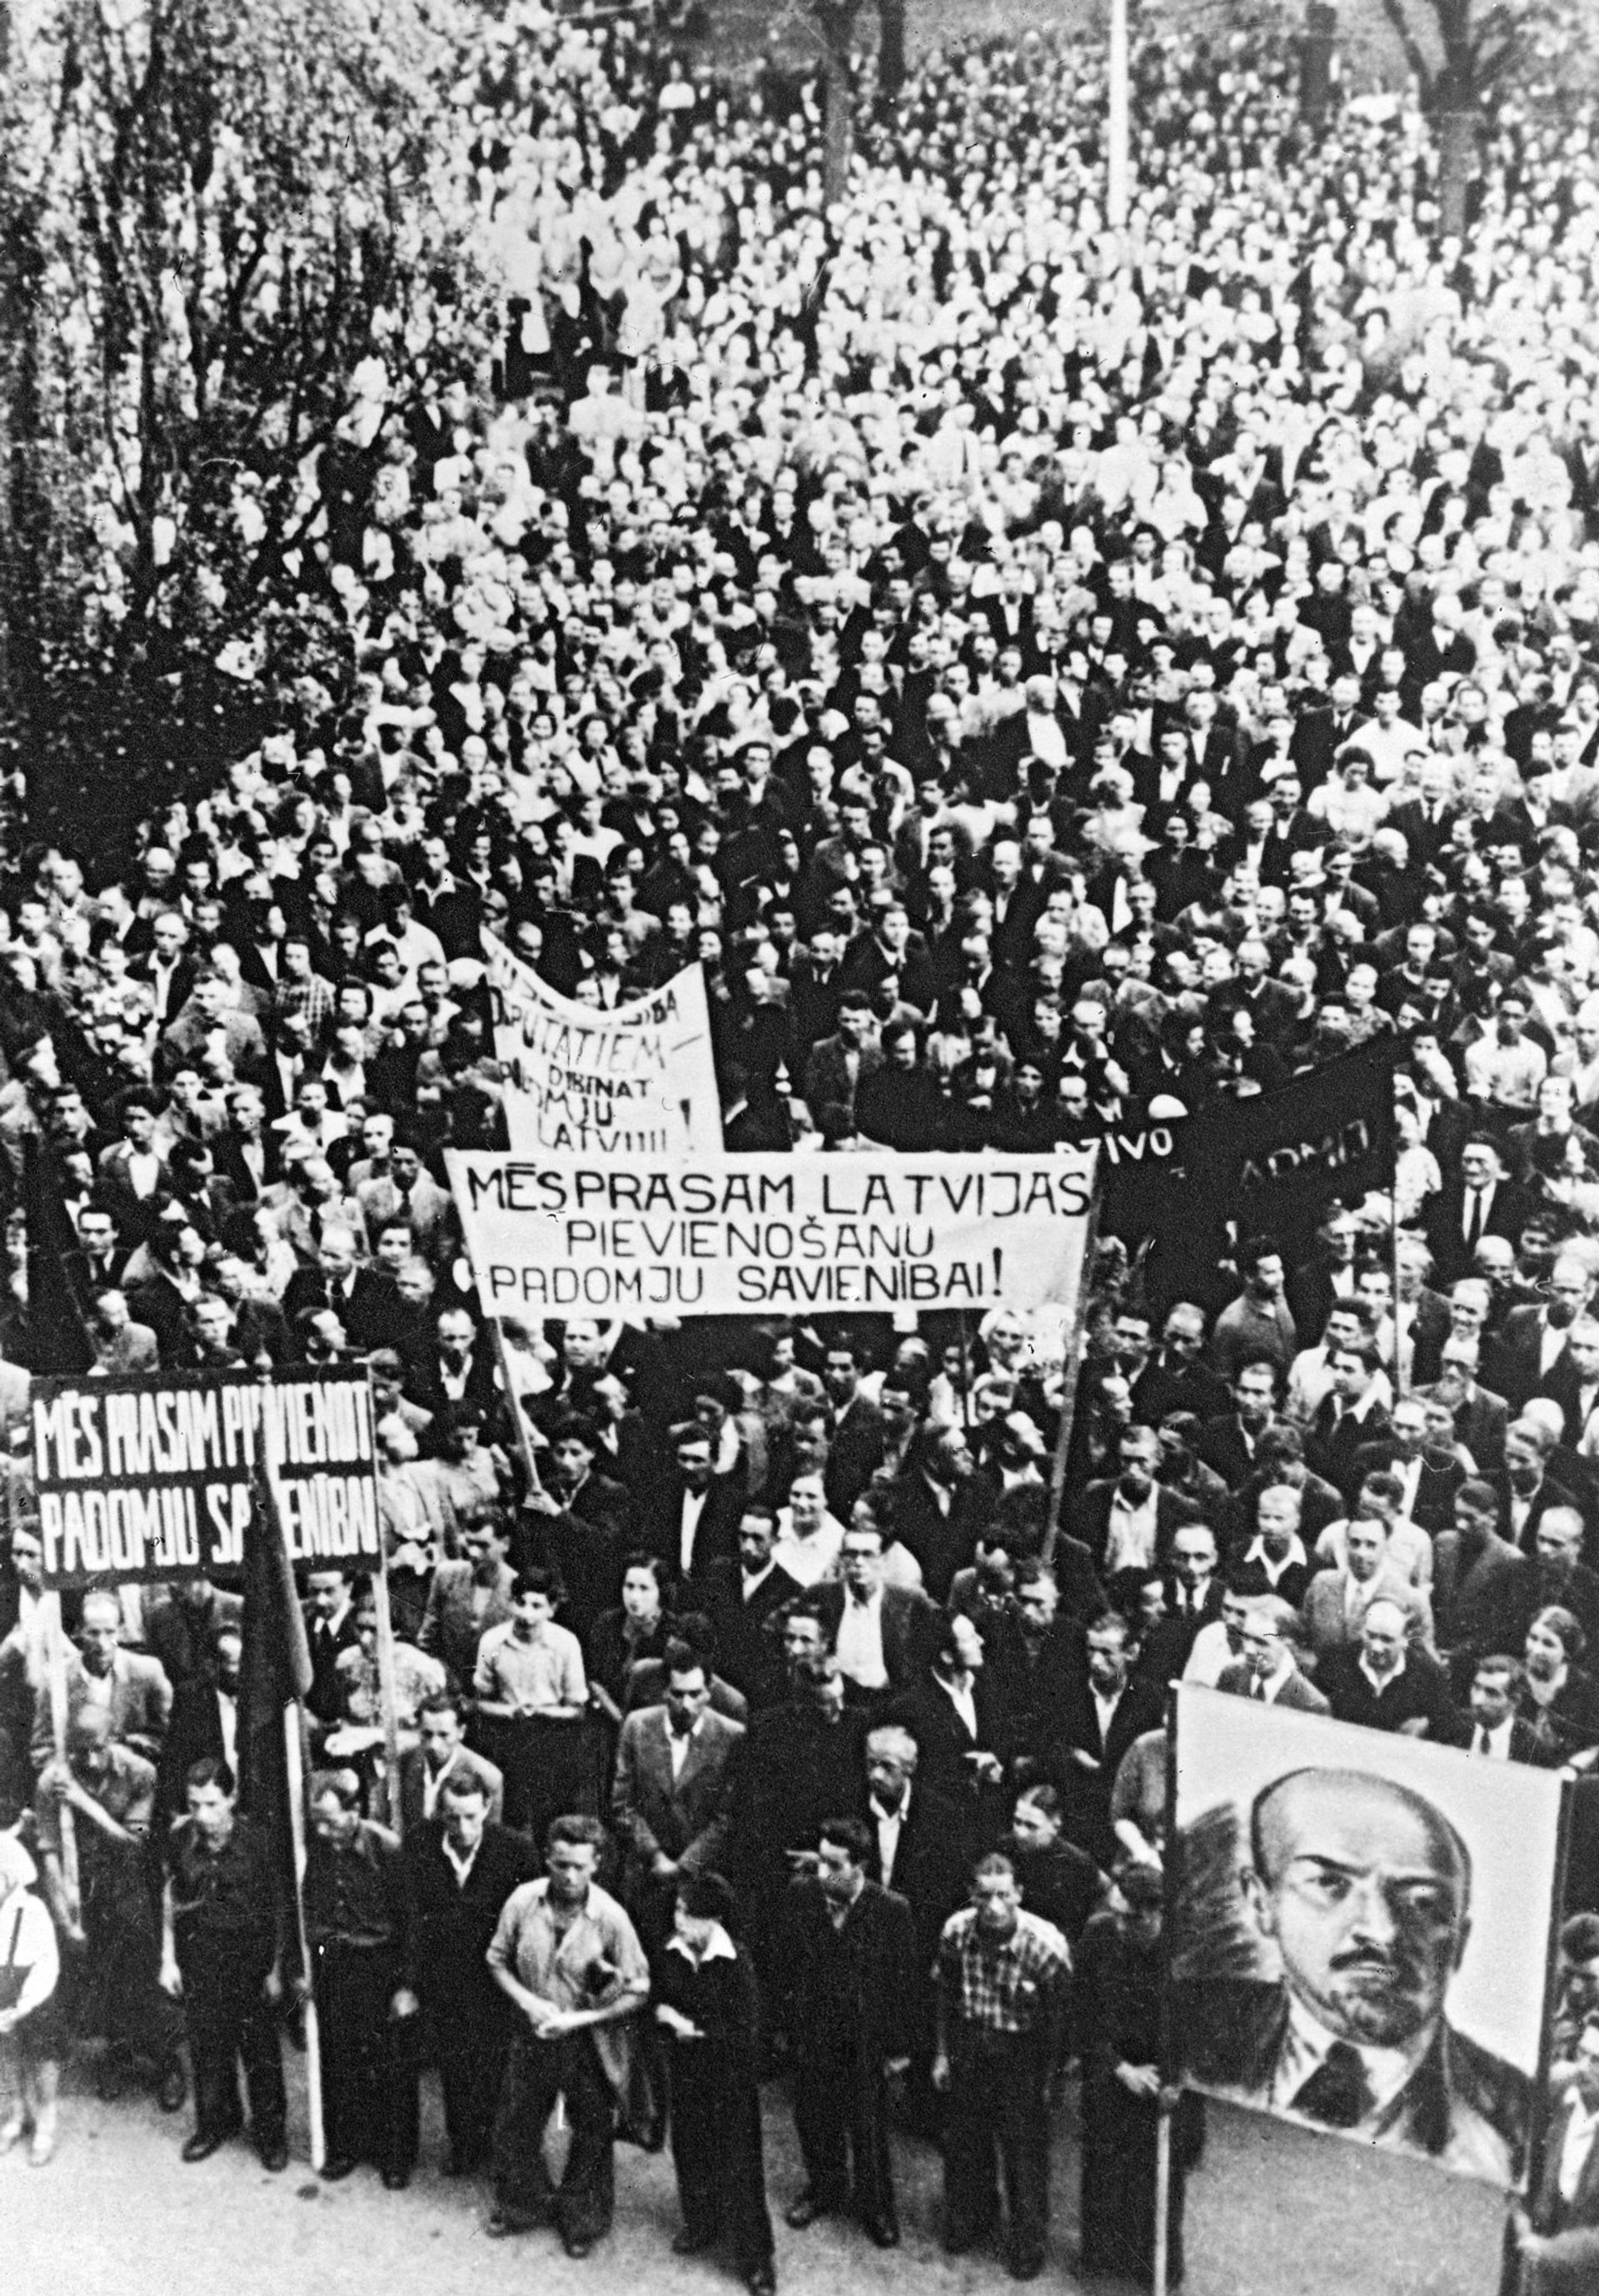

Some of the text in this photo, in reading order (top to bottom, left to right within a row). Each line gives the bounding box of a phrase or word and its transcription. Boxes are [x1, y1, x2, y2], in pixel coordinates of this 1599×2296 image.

[466, 1163, 1091, 1217] MĒS PRASAM LATVIJAS
[568, 1215, 934, 1259] PIEVIENOŠANU
[490, 1265, 703, 1304] PADOMJU
[33, 1390, 102, 1481] MĒS
[40, 1487, 200, 1573] PADOMJU
